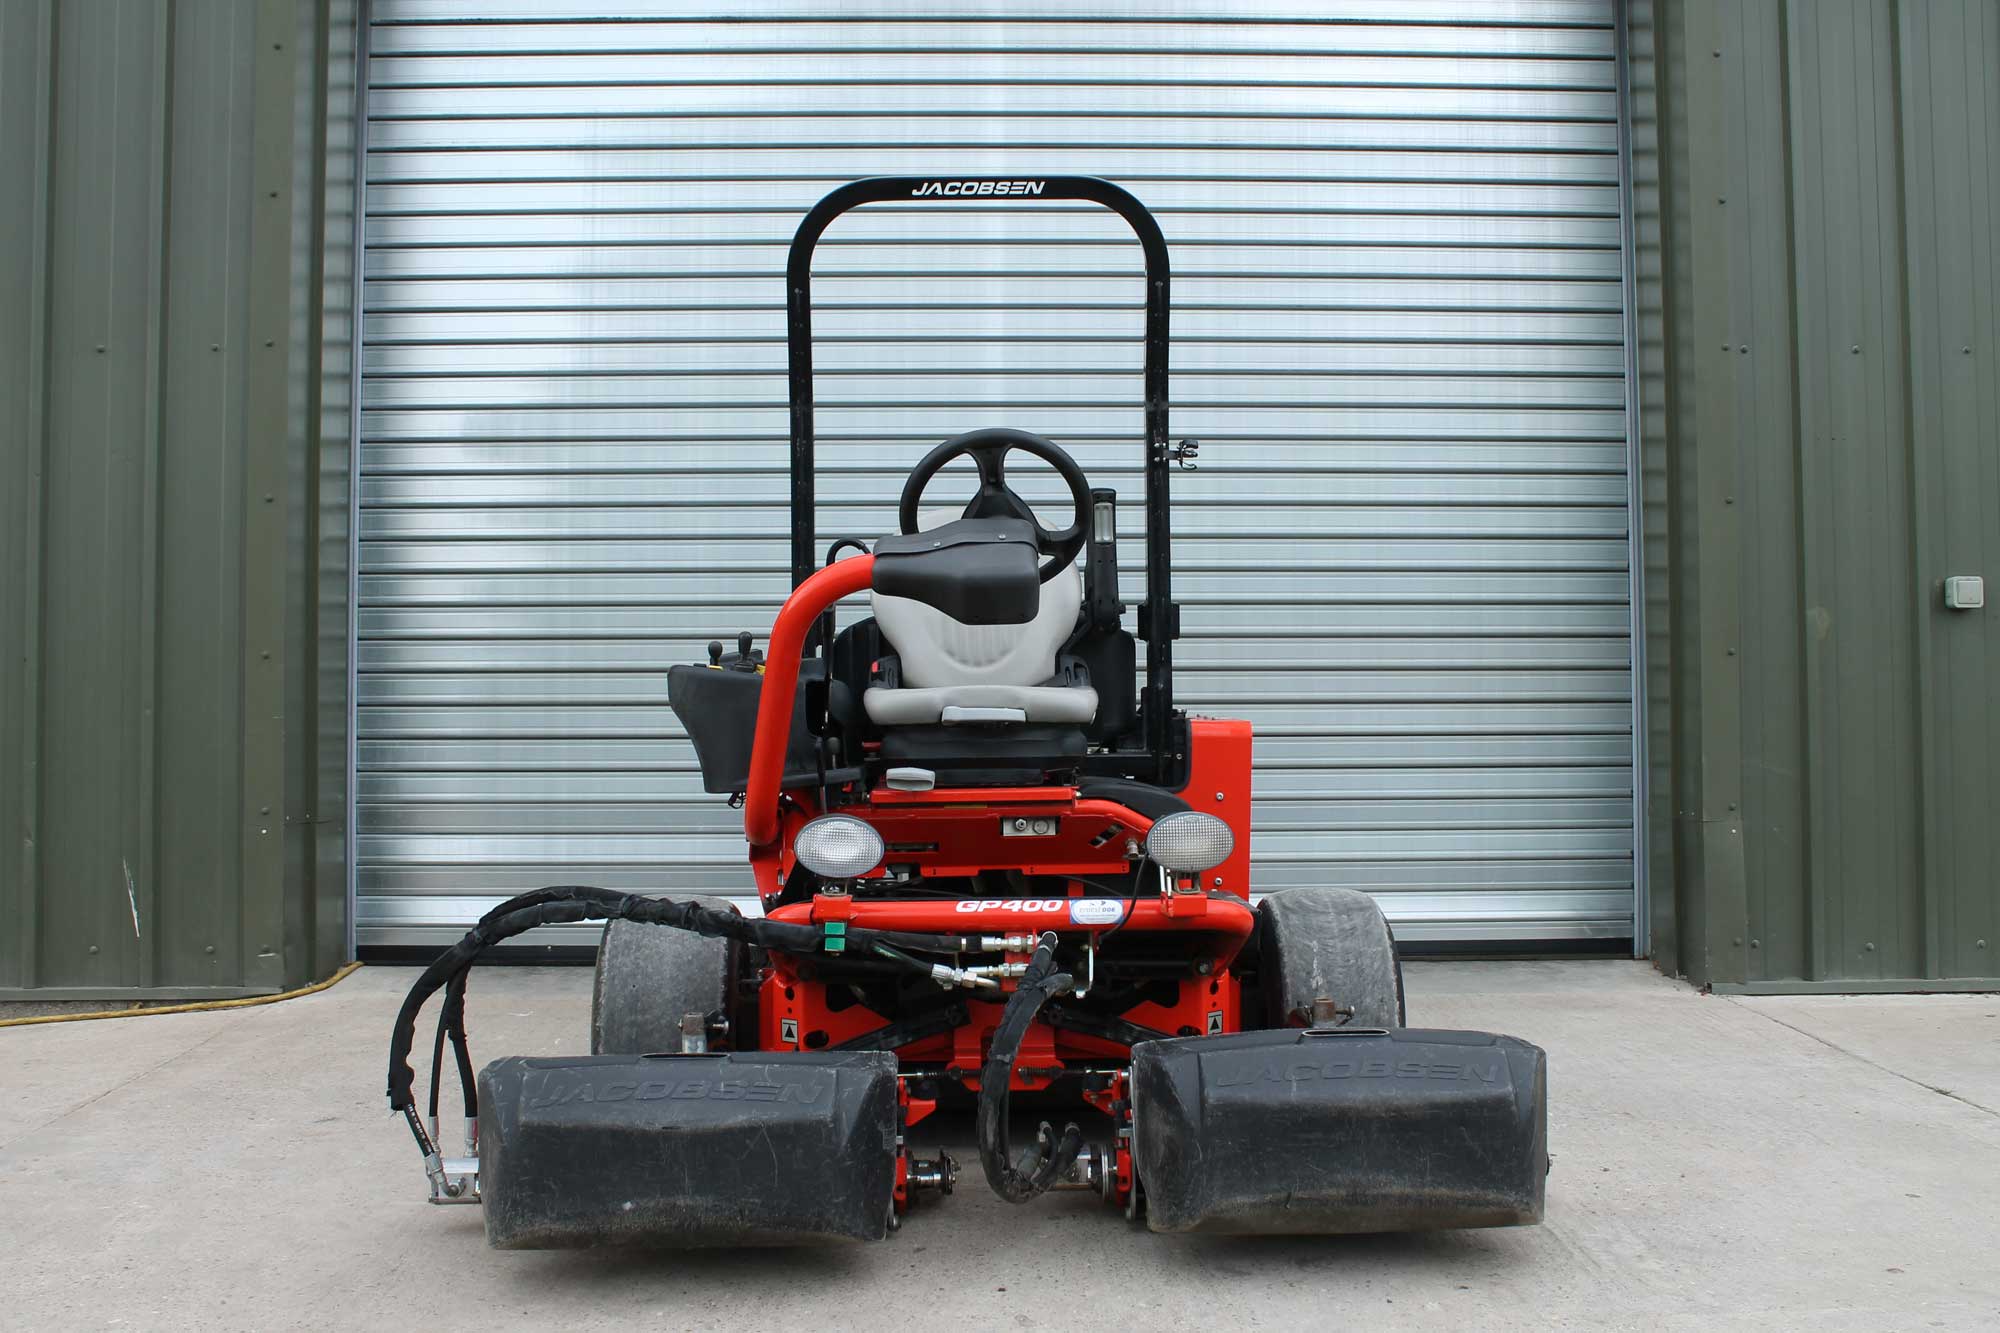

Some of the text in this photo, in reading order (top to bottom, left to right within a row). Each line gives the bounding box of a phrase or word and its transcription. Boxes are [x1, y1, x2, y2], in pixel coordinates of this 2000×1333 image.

[911, 180, 1046, 196] JACOBSEN
[955, 899, 1064, 913] GP400
[1216, 1062, 1499, 1088] JACOBSEN
[531, 1080, 824, 1108] JACOBSEN
